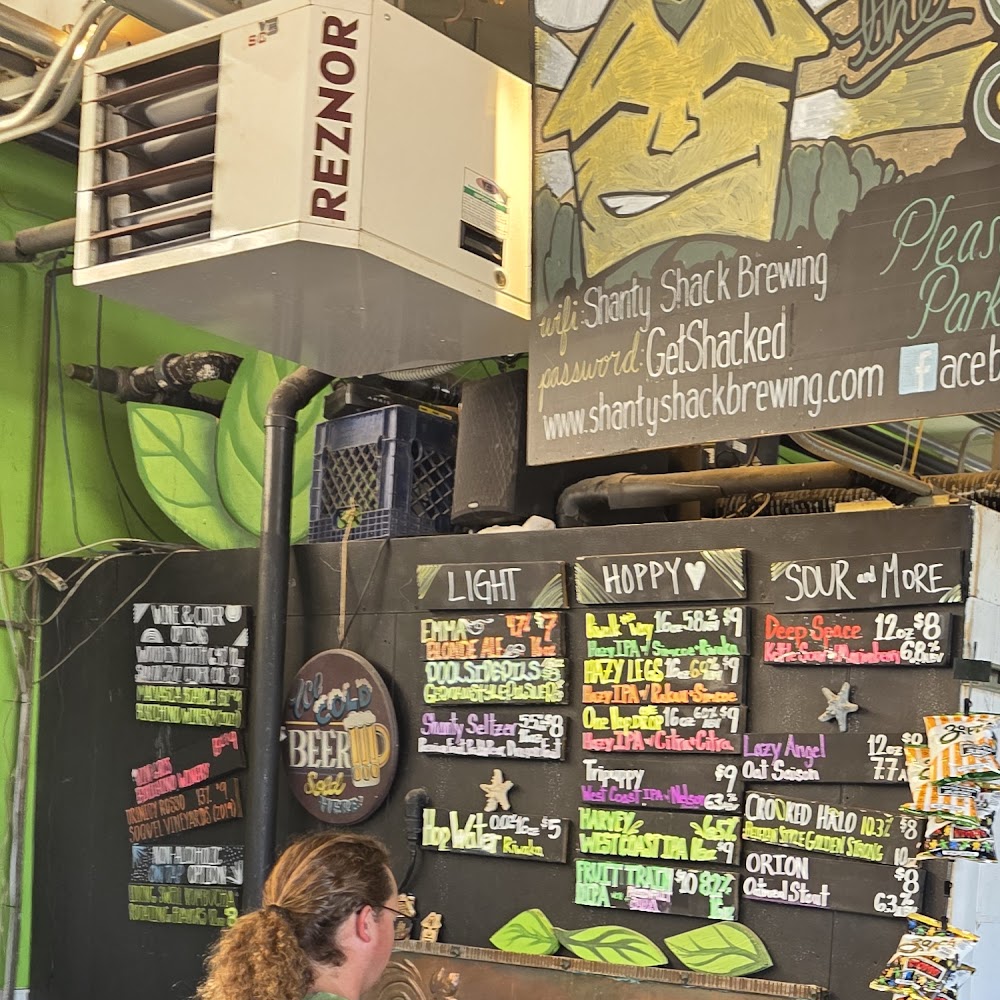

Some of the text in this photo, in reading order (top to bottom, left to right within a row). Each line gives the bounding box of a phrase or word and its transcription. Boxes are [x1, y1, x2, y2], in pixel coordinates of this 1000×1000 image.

[311, 16, 359, 221] REZNOR
[584, 279, 651, 333] Shanty
[661, 259, 731, 313] Shack
[738, 245, 828, 302] Brewing
[646, 304, 786, 377] GetShacked
[542, 363, 884, 441] www.shantyshackbrewing.com
[448, 568, 522, 605] LIGHT
[602, 557, 681, 594] HOPPY
[785, 553, 953, 601] SOUR MORE
[420, 618, 467, 643] EMMA
[723, 607, 743, 637] $9
[764, 612, 941, 649] Deep Space 12oz $8
[426, 638, 479, 660] BLONDE
[587, 639, 641, 658] Hazy IPA
[584, 658, 625, 684] HAZY
[627, 658, 665, 683] LEGS
[722, 656, 740, 684] $9
[312, 678, 373, 725] COLD
[582, 684, 640, 704] Hazy IPA
[420, 712, 519, 744] Shanty Seltzer
[582, 706, 611, 730] One
[663, 706, 697, 727] 16oz
[720, 706, 740, 734] $9
[288, 729, 351, 768] BEER
[582, 732, 615, 751] Hazy
[613, 730, 645, 751] IPA
[654, 729, 692, 751] Citra
[696, 730, 735, 751] Citra
[743, 735, 782, 765] Lazy
[784, 734, 826, 768] Angel
[867, 734, 903, 756] 12oz
[714, 763, 738, 793] $9
[742, 760, 820, 781] Oat Saison
[159, 794, 186, 813] ROSSO
[319, 796, 364, 814] HERE
[581, 784, 705, 807] West Coast IPA Nelson
[163, 807, 211, 836] VINEYARDS
[422, 808, 562, 854] Hop Water $5
[579, 808, 636, 834] HARVEY
[745, 793, 918, 840] CROOKED HALO $8
[580, 832, 734, 864] WEST COAST IPA $9
[746, 853, 920, 894] ORION $8
[743, 877, 831, 907] Oatmeal Stout
